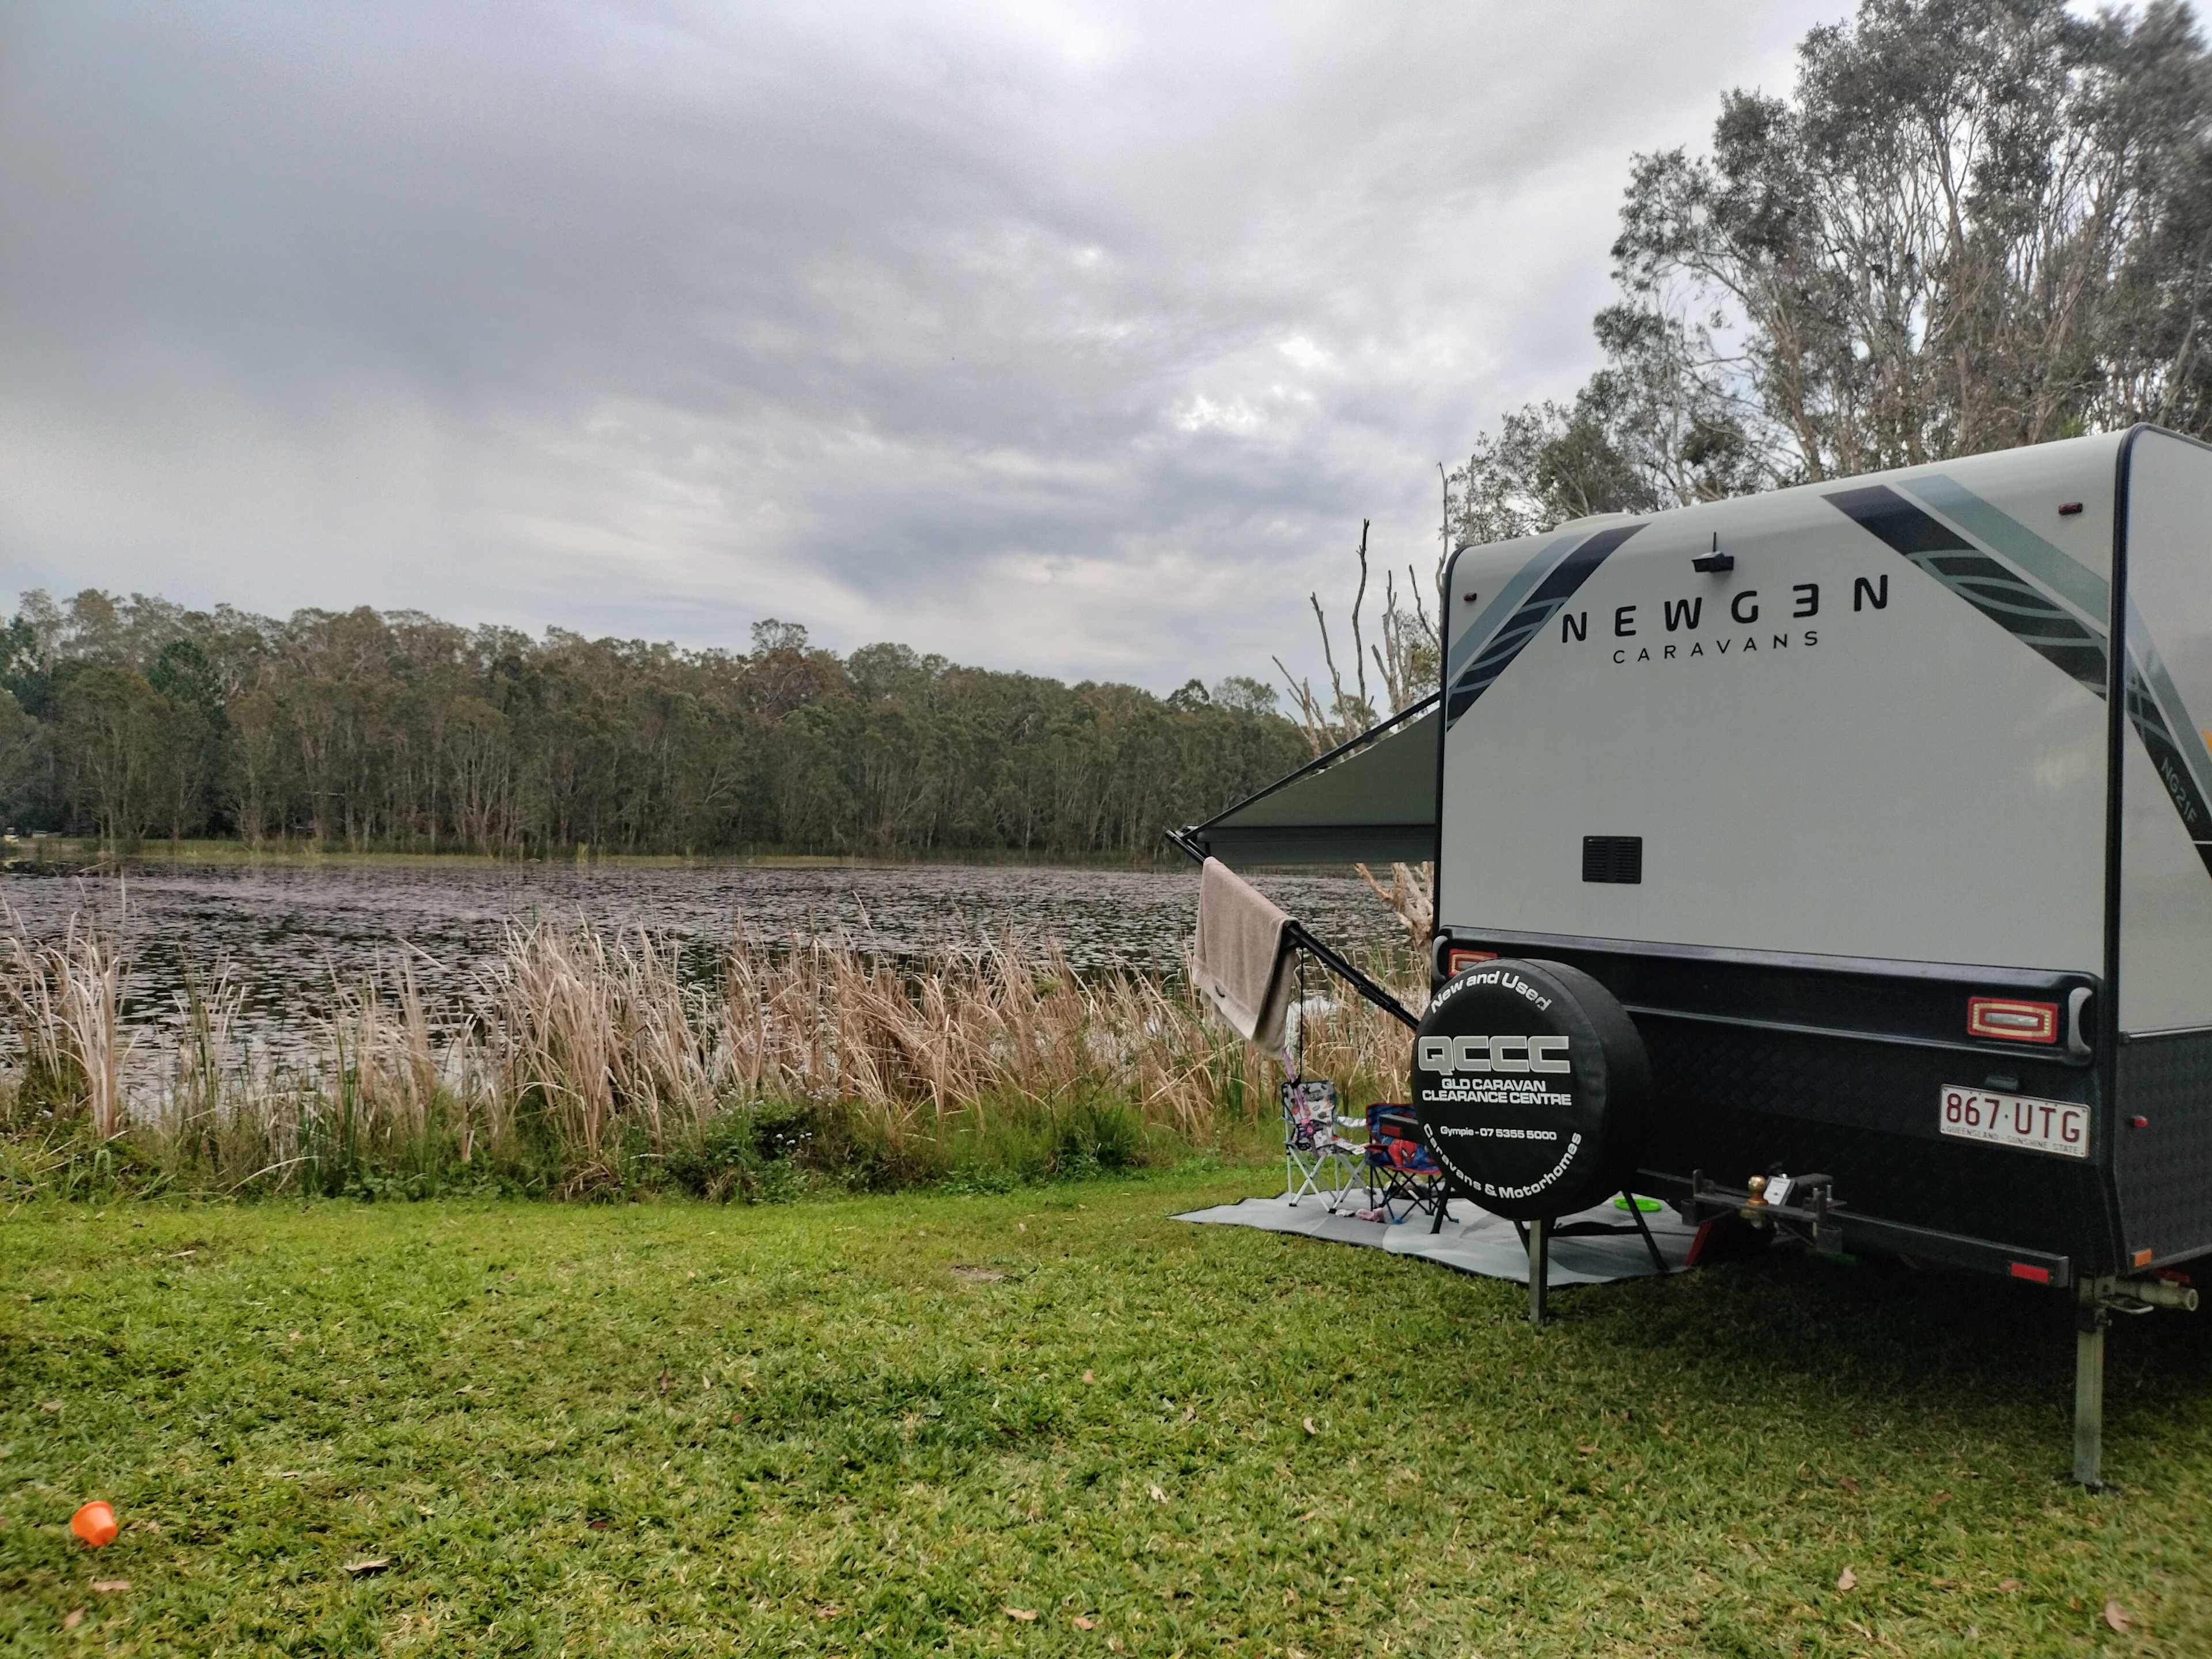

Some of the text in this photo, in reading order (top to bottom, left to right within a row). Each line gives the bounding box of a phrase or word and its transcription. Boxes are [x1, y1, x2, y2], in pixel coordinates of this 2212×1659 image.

[1613, 631, 1818, 664] CARAVANS
[1431, 971, 1552, 1014] New and Used
[1418, 1035, 1571, 1075] QCCC
[1441, 1078, 1546, 1092] QLD CARAVAN
[1422, 1090, 1572, 1106] CLEARANCE CENTRE
[1440, 1125, 1475, 1137] Gympie
[1480, 1127, 1494, 1137] 07
[1526, 1130, 1558, 1141] 5000
[2052, 1143, 2079, 1154] STATE
[1423, 1123, 1582, 1199] Caravans & Motorhomes
